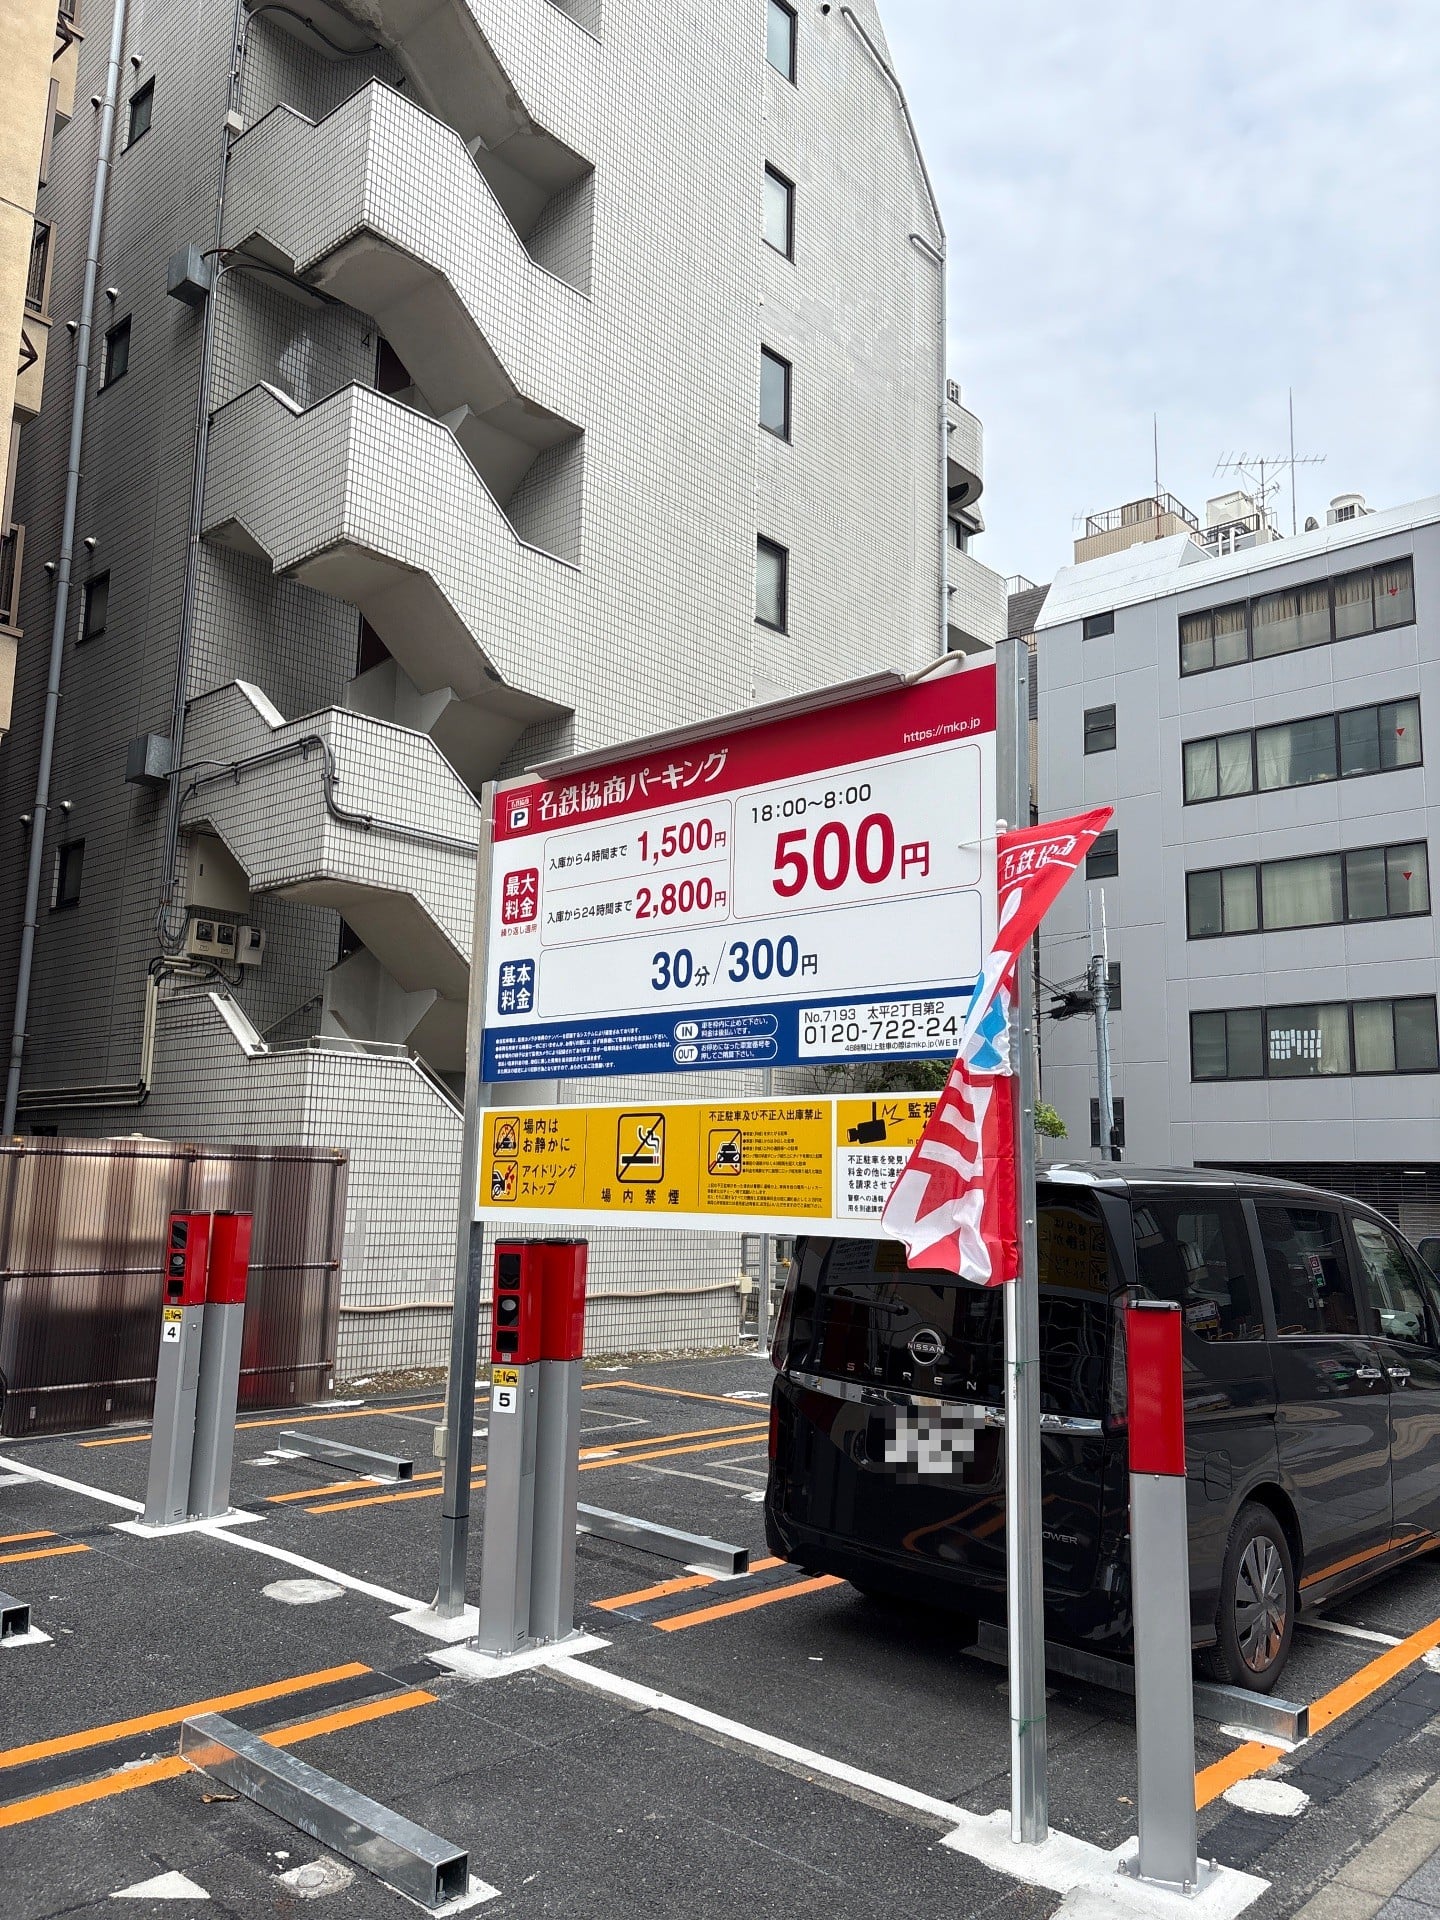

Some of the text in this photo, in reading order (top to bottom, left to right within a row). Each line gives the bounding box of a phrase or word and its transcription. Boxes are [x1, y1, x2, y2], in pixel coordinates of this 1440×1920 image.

[904, 717, 981, 743] https://mkp.jp
[537, 748, 729, 821] 名鉄協商パーキング
[513, 811, 526, 826] P
[549, 818, 727, 870] 入庫から4時間まで 1,500円
[772, 813, 929, 897] 500円
[506, 873, 535, 896] 最大
[547, 877, 727, 924] 入庫から24時間まで 2,800円
[505, 898, 535, 920] 料金
[501, 964, 531, 986] 基本
[500, 988, 531, 1011] 料金
[804, 1002, 945, 1023] No.7193 太平2丁目第2
[681, 1025, 693, 1038] IN
[678, 1048, 694, 1060] OUT
[708, 1109, 823, 1122] 不正駐車及び不正入出庫禁止
[524, 1118, 558, 1134] 場内は
[522, 1138, 571, 1153] お静かに
[522, 1163, 577, 1178] アイドリング
[521, 1182, 557, 1195] ストップ
[601, 1188, 680, 1205] 場内禁煙
[167, 1326, 177, 1338] 4
[907, 1342, 945, 1355] NISSAN
[846, 1362, 1005, 1394] SEREN
[499, 1392, 511, 1408] 5
[1042, 1531, 1078, 1545] OWER
